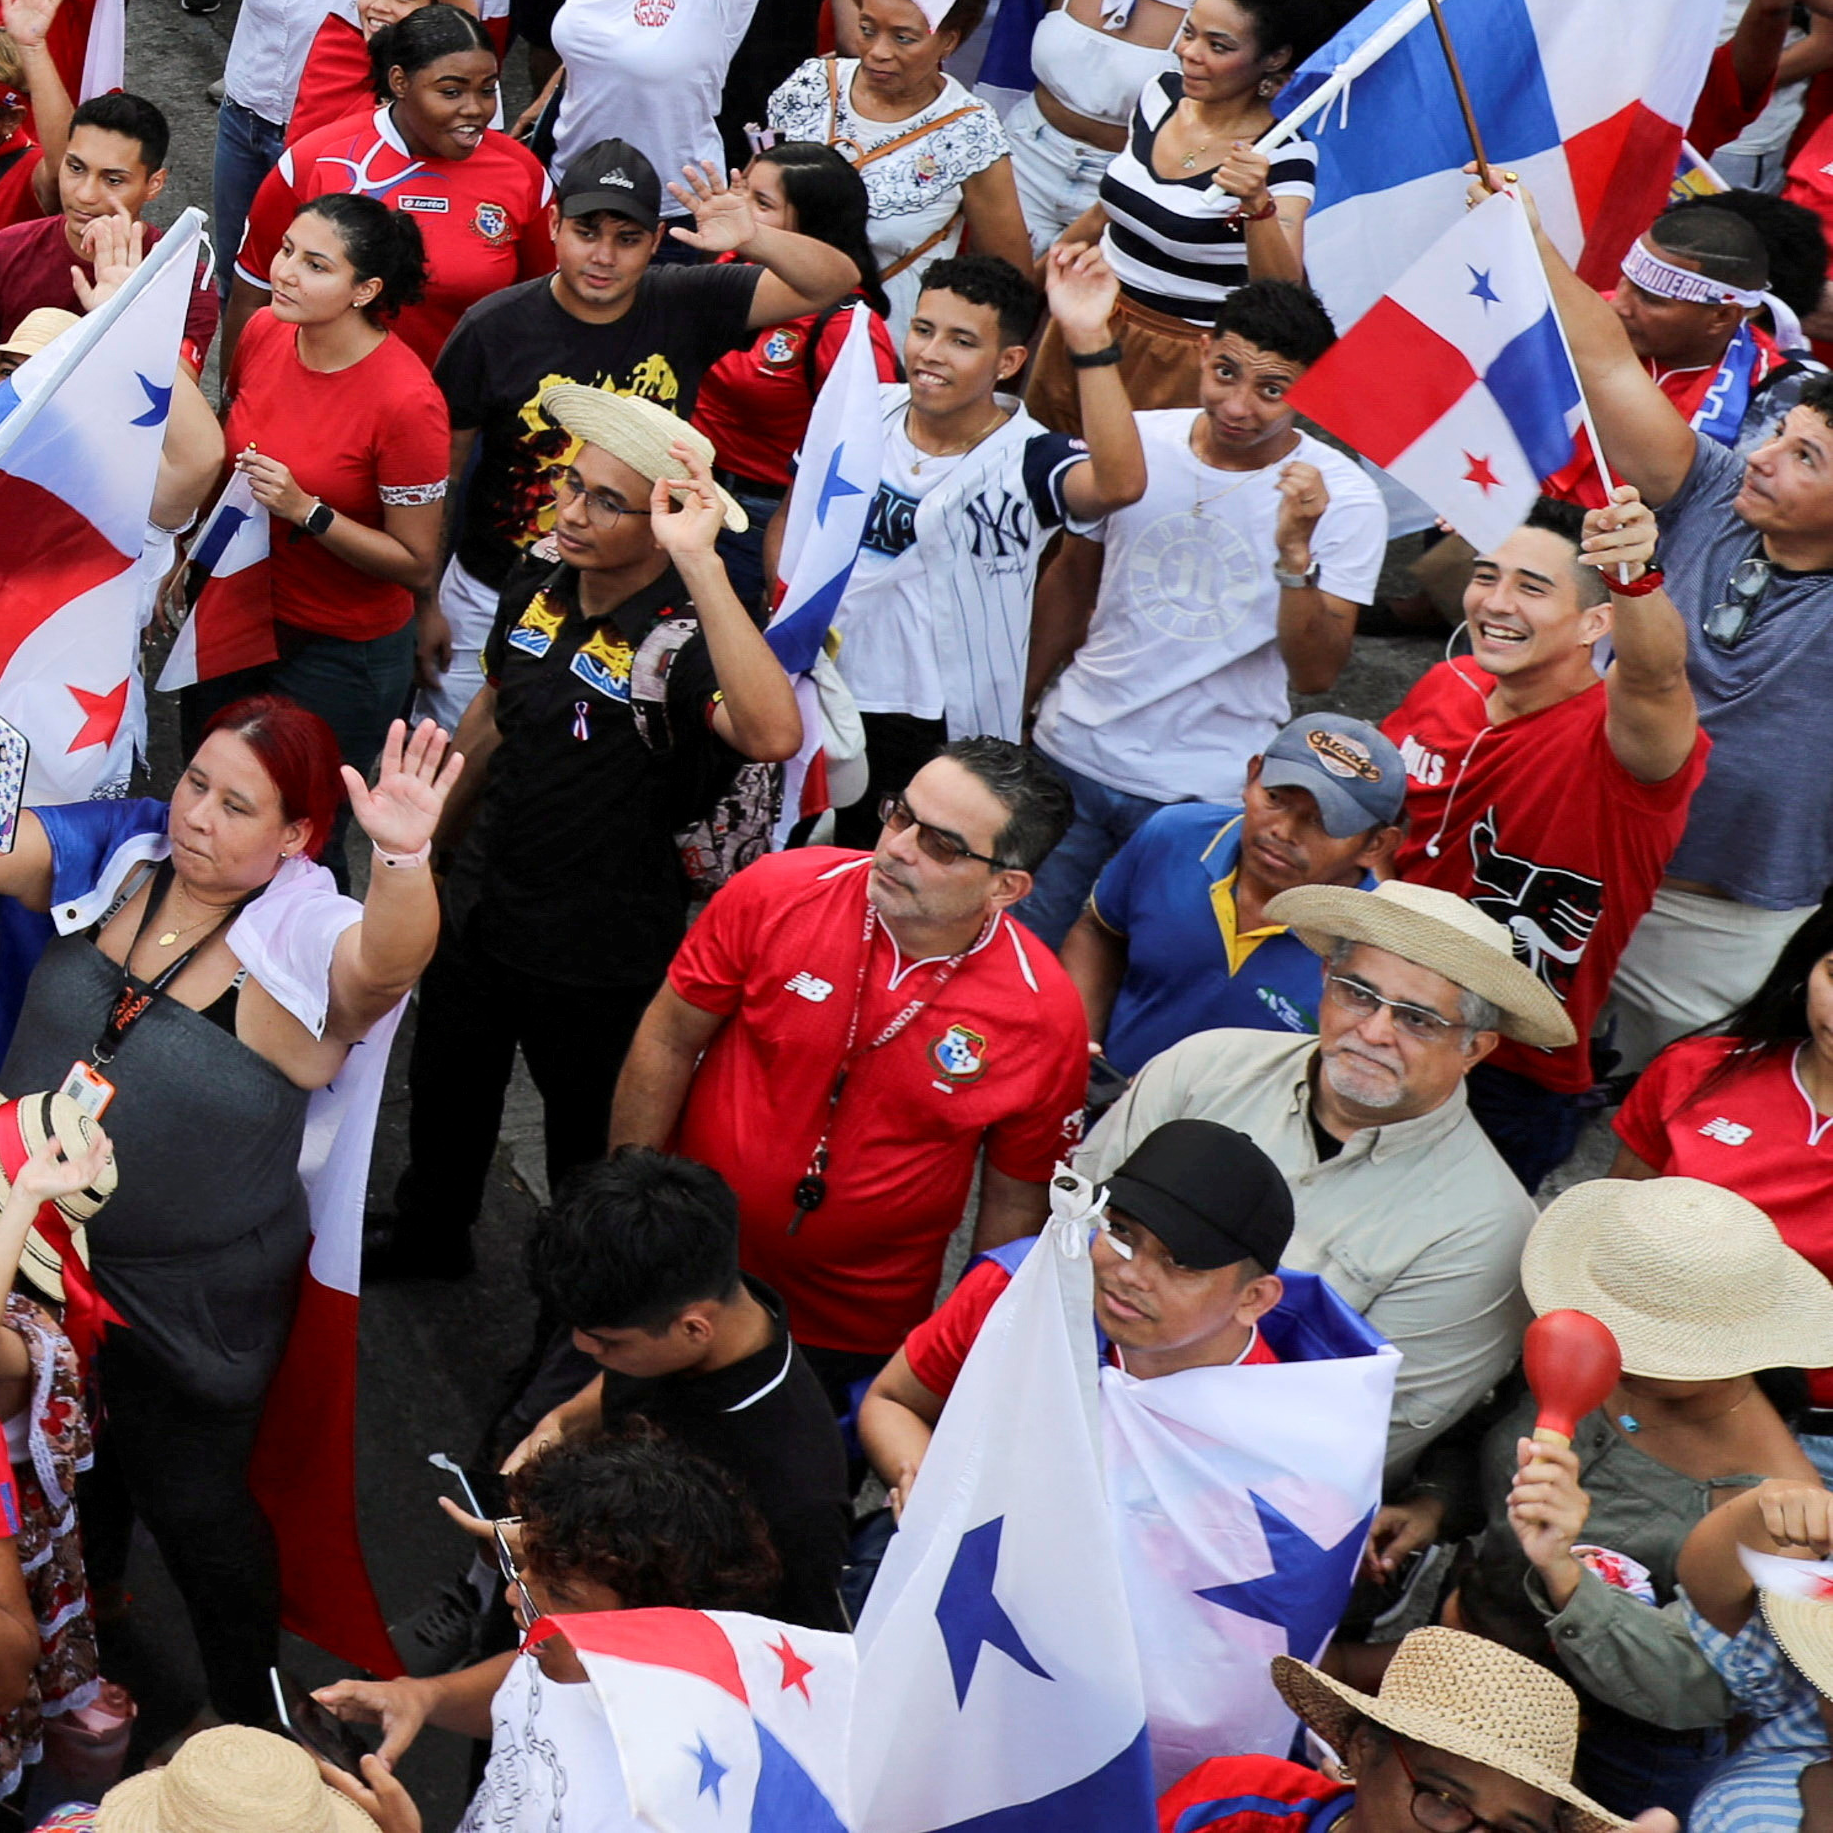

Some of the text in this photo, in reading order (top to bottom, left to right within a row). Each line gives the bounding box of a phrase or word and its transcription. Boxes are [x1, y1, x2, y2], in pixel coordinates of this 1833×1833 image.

[599, 176, 634, 189] adidas
[964, 491, 1030, 557] NY
[873, 1000, 926, 1046] HONDA
